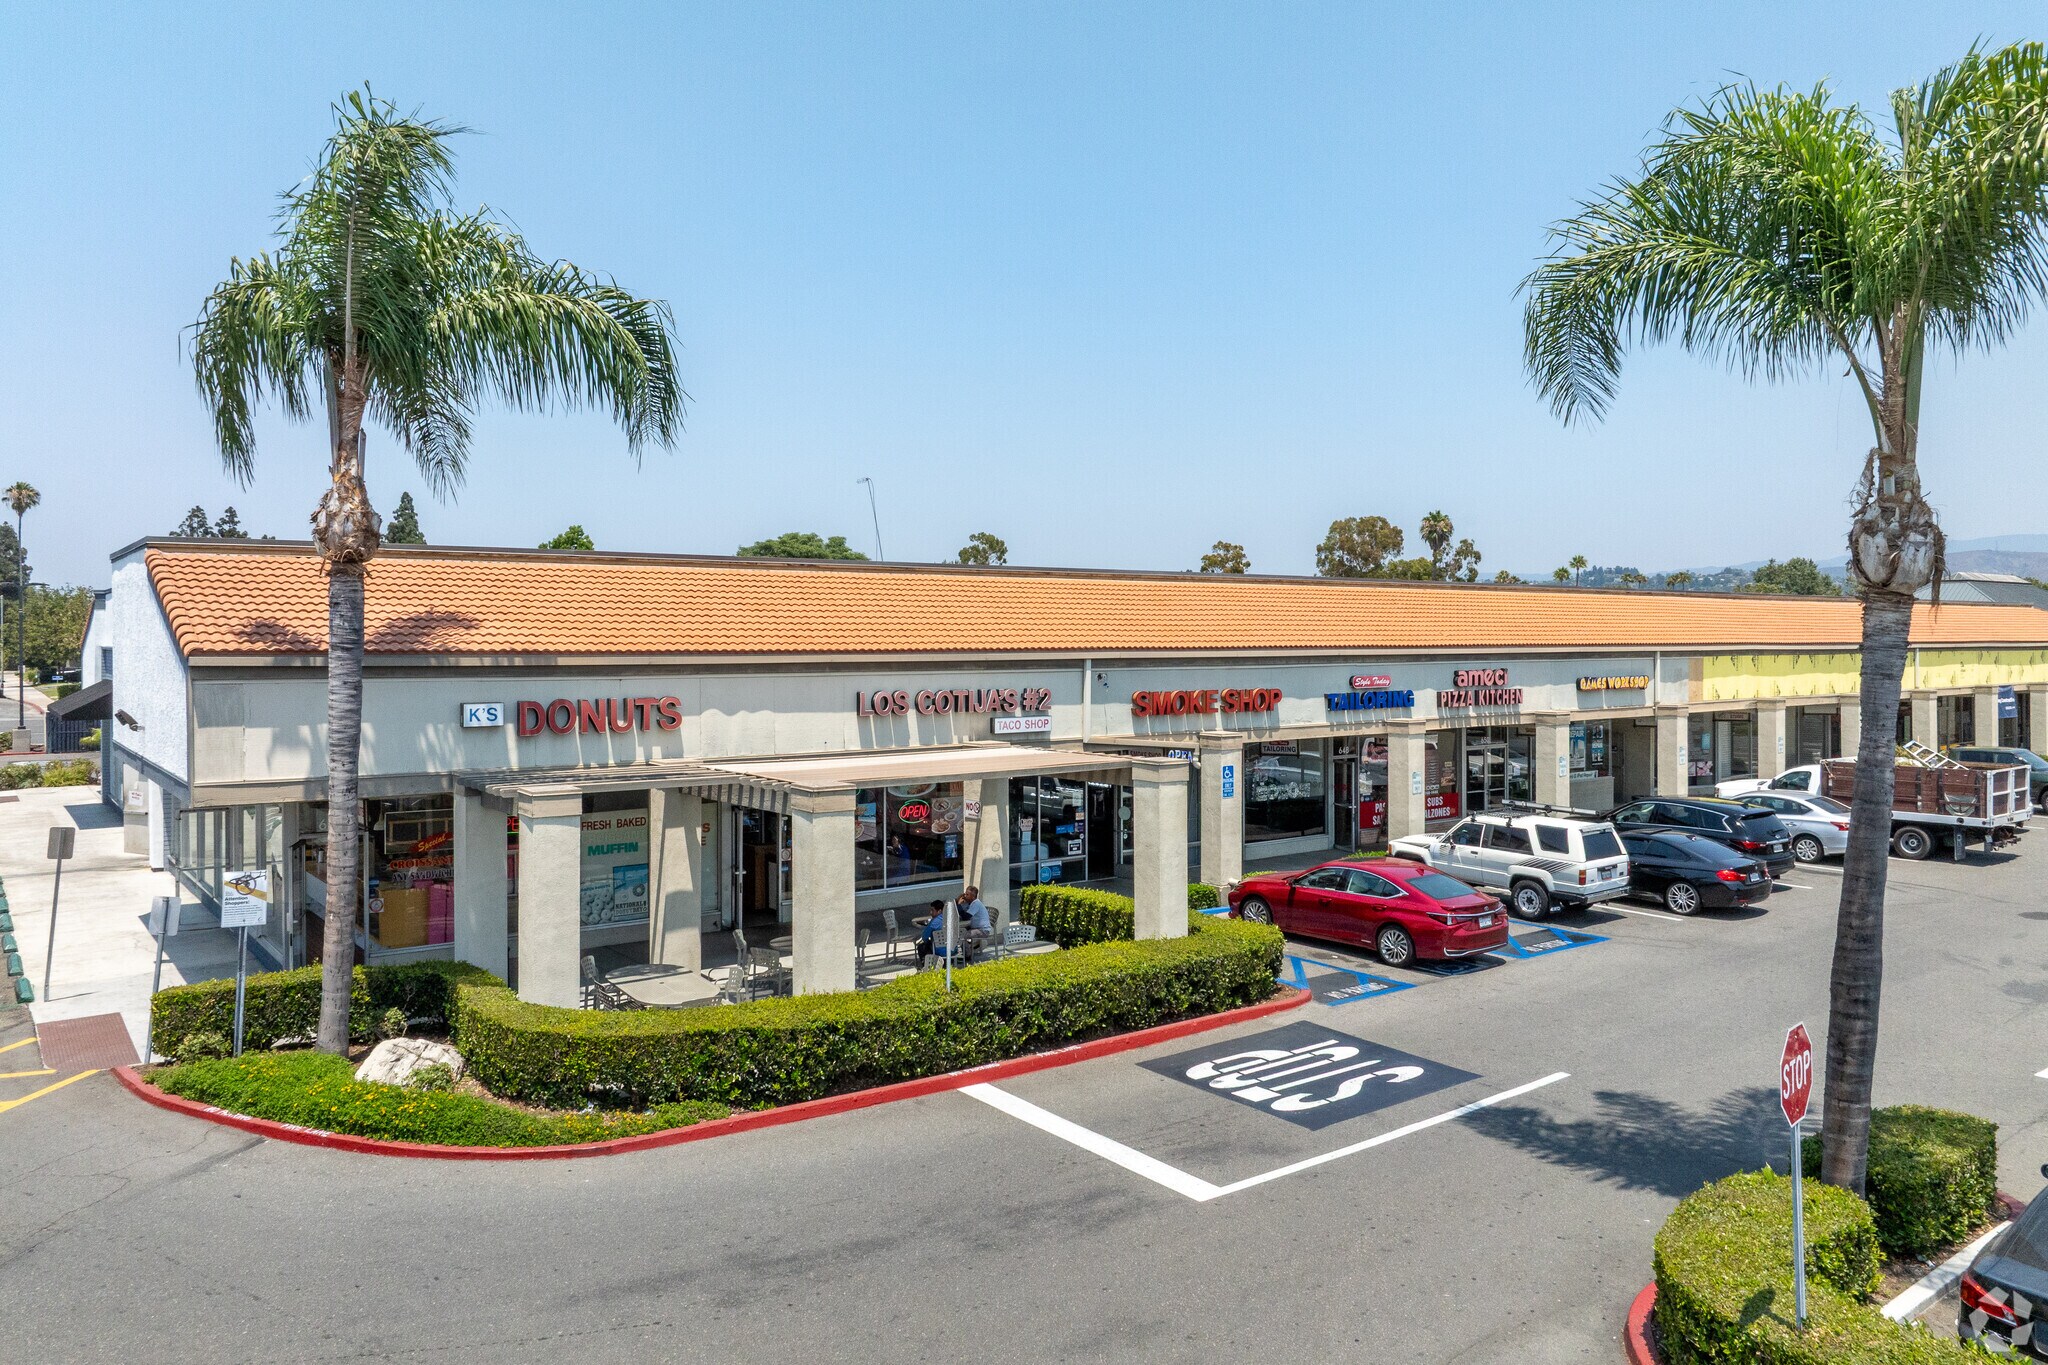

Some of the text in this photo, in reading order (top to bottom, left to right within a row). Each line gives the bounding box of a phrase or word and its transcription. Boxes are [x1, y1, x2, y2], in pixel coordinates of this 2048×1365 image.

[1354, 677, 1391, 687] Style Today
[1454, 668, 1508, 687] ameci
[1577, 675, 1649, 690] GAMES WORKSHOP
[857, 687, 1052, 717] LOS COTIJA'S #2
[1132, 688, 1283, 717] SMOKE SHOP
[1325, 689, 1415, 711] TAILORING
[1438, 688, 1523, 707] PIZZA KITCHEN
[469, 707, 498, 722] K'S
[518, 697, 682, 737] DONUTS
[997, 718, 1049, 731] TACO SHOP
[1263, 745, 1297, 753] TAILORING
[1427, 796, 1443, 807] SUBS
[900, 804, 927, 819] OPEN
[1424, 806, 1451, 819] ALZONES
[581, 816, 647, 831] FRESH BAKED
[417, 834, 447, 852] Special
[587, 842, 639, 856] MUFFIN
[392, 872, 408, 882] ANY
[615, 901, 644, 909] NATIONAL
[1185, 1039, 1424, 1112] STOP
[1783, 1049, 1810, 1100] STOP
